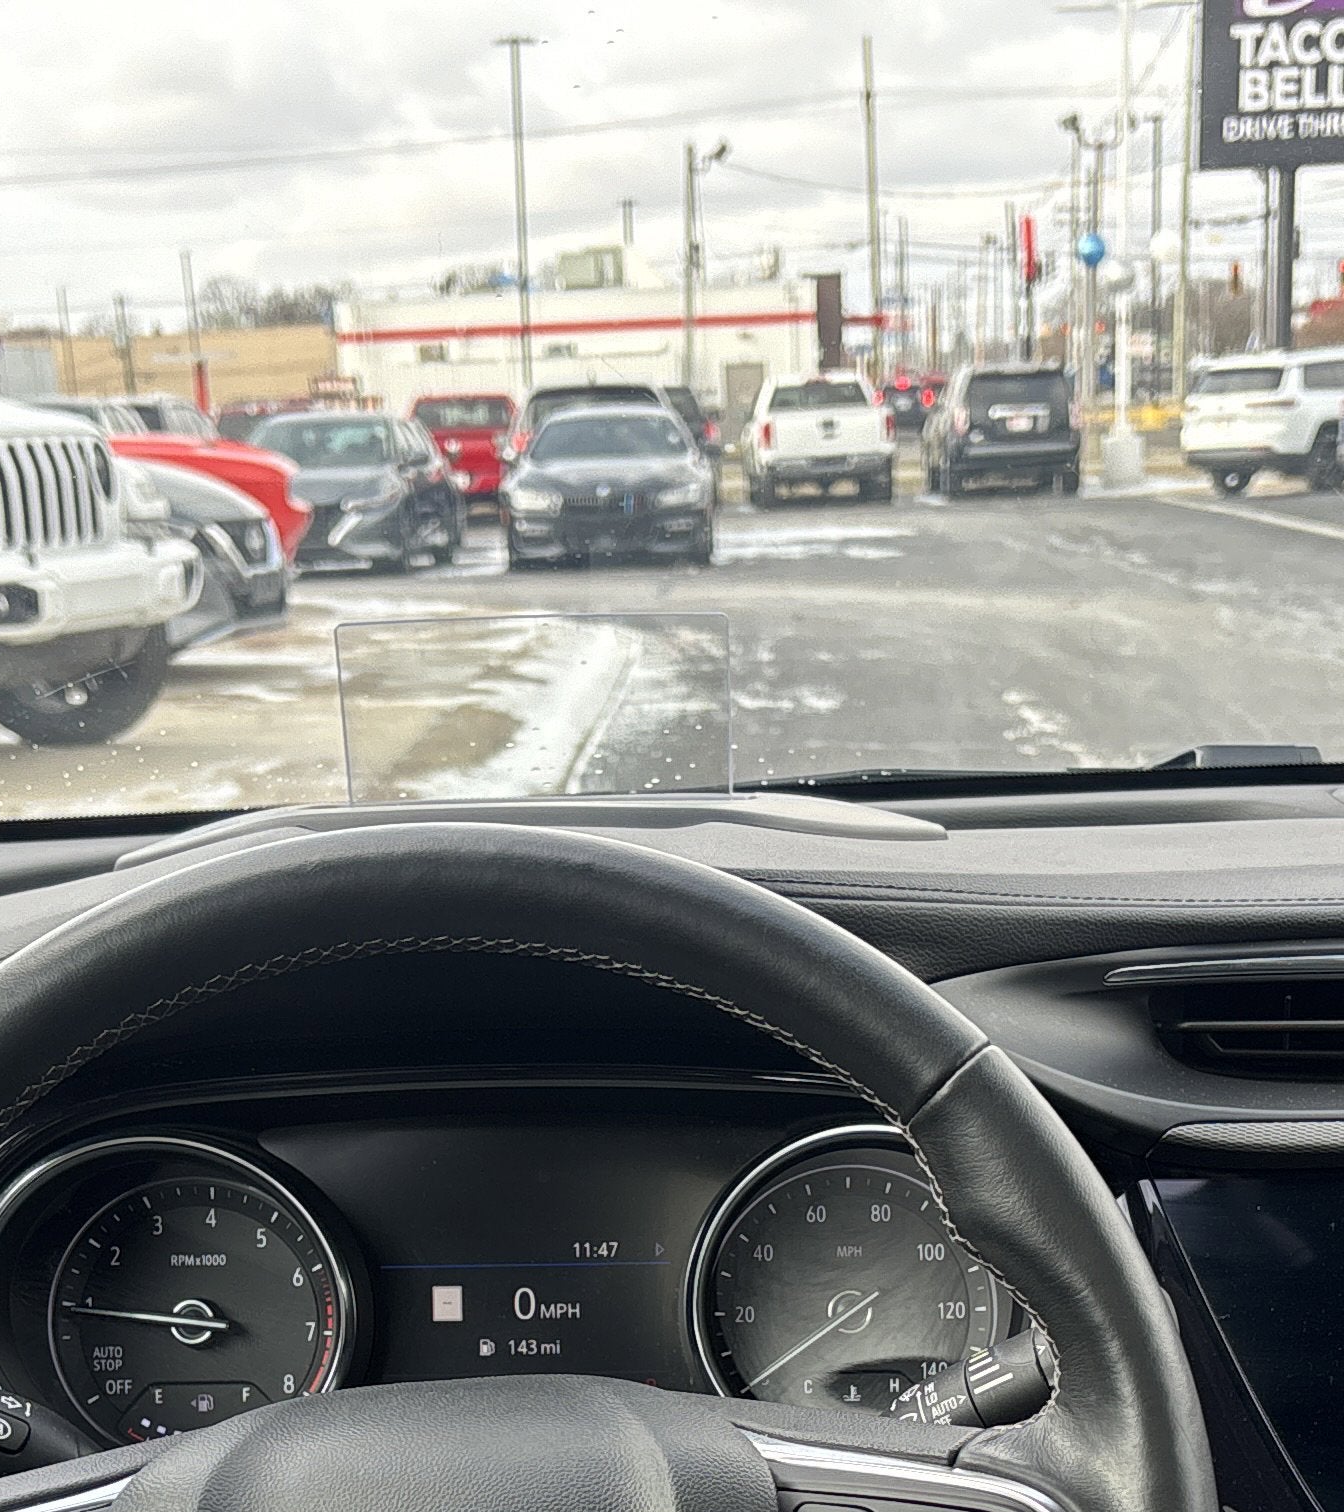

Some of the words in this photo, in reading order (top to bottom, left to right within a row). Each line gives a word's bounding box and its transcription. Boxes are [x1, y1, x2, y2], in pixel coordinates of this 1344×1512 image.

[1222, 114, 1295, 143] DRIVE
[205, 1208, 218, 1227] 4
[806, 1205, 827, 1224] 60
[870, 1204, 892, 1223] 80
[152, 1215, 164, 1236] 3
[256, 1228, 268, 1248] 5
[109, 1246, 121, 1266] 2
[572, 1241, 620, 1259] 11:47
[752, 1244, 775, 1263] 40
[836, 1245, 863, 1258] MPH
[916, 1243, 945, 1262] 100
[291, 1267, 305, 1288] 6
[513, 1286, 537, 1321] 0
[539, 1302, 582, 1320] MPH
[937, 1301, 967, 1320] 120
[734, 1305, 755, 1324] 20
[305, 1321, 317, 1342] 7
[92, 1345, 124, 1359] AUTO
[507, 1338, 537, 1356] 143
[540, 1339, 561, 1355] mi
[93, 1358, 124, 1372] STOP
[105, 1378, 134, 1395] OFF
[282, 1374, 295, 1394] 8
[803, 1379, 813, 1395] C
[889, 1378, 900, 1393] H
[154, 1388, 164, 1405] E
[241, 1386, 251, 1403] F
[925, 1391, 938, 1406] LO
[931, 1396, 958, 1419] AUTO
